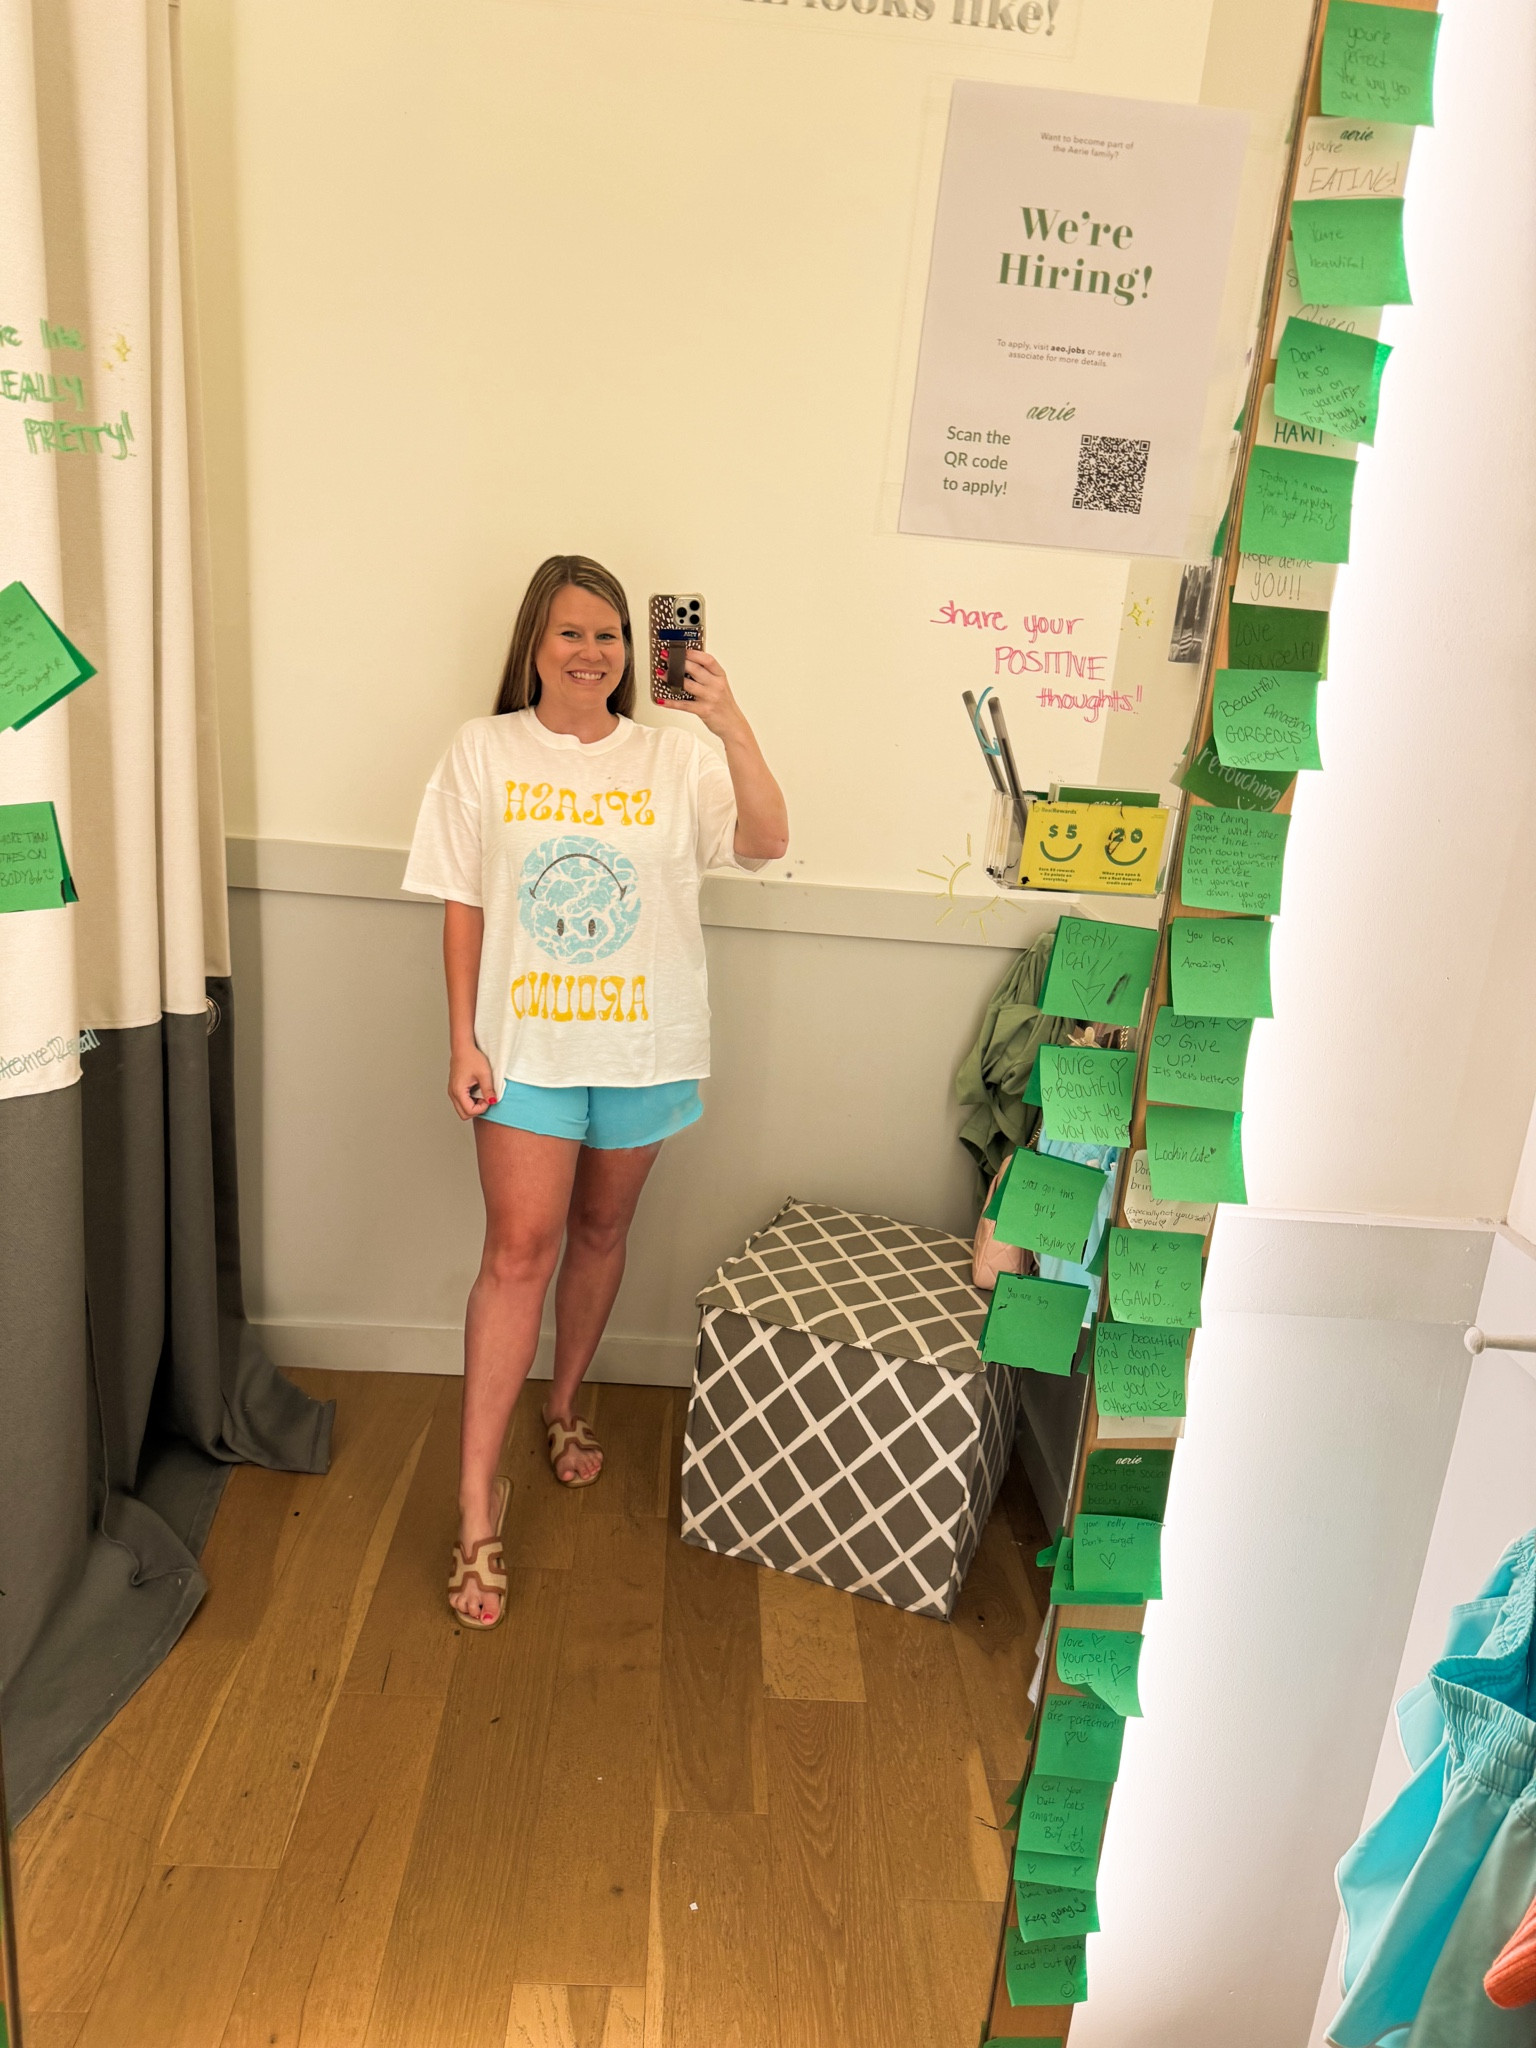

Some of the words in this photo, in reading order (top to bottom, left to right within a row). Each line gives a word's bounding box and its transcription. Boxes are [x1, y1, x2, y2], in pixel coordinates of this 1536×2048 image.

[1041, 133, 1061, 141] Want
[1073, 137, 1105, 146] become
[1340, 127, 1374, 140] aerie
[1053, 144, 1065, 152] the
[1068, 146, 1088, 155] Aerie
[1092, 149, 1119, 159] family?
[1020, 206, 1133, 250] We're
[997, 252, 1152, 307] Hiring!
[997, 339, 1006, 347] To
[1008, 341, 1031, 350] apply,
[1033, 342, 1049, 350] visit
[1050, 345, 1085, 354] aeo.jobs
[1008, 350, 1043, 361] associate
[1046, 354, 1057, 362] for
[1059, 356, 1079, 364] more
[1296, 368, 1309, 379] be
[0, 370, 84, 412] EALLY
[1027, 402, 1076, 421] aerie
[946, 426, 981, 443] Scan
[986, 430, 1011, 445] the
[944, 452, 967, 468] QR
[971, 454, 1008, 470] code
[943, 477, 958, 490] to
[962, 479, 1007, 497] apply!
[1024, 615, 1084, 643] your
[994, 646, 1108, 680] POSITIVE
[1219, 676, 1280, 717] Beautiful
[1226, 725, 1301, 744] GORGEOUS
[1191, 834, 1216, 843] people
[1194, 824, 1219, 833] about
[1257, 830, 1278, 839] other
[1216, 849, 1243, 857] doubt
[1187, 866, 1208, 874] and
[1258, 892, 1270, 902] got
[1179, 1034, 1220, 1053] Give
[1099, 1103, 1124, 1121] the
[1115, 1234, 1128, 1256] OH
[1129, 1262, 1146, 1276] MY
[1098, 1360, 1119, 1375] let
[1124, 1363, 1171, 1382] anyone
[1098, 1381, 1115, 1393] tell
[1124, 1381, 1147, 1399] you
[1115, 1455, 1143, 1465] aerie
